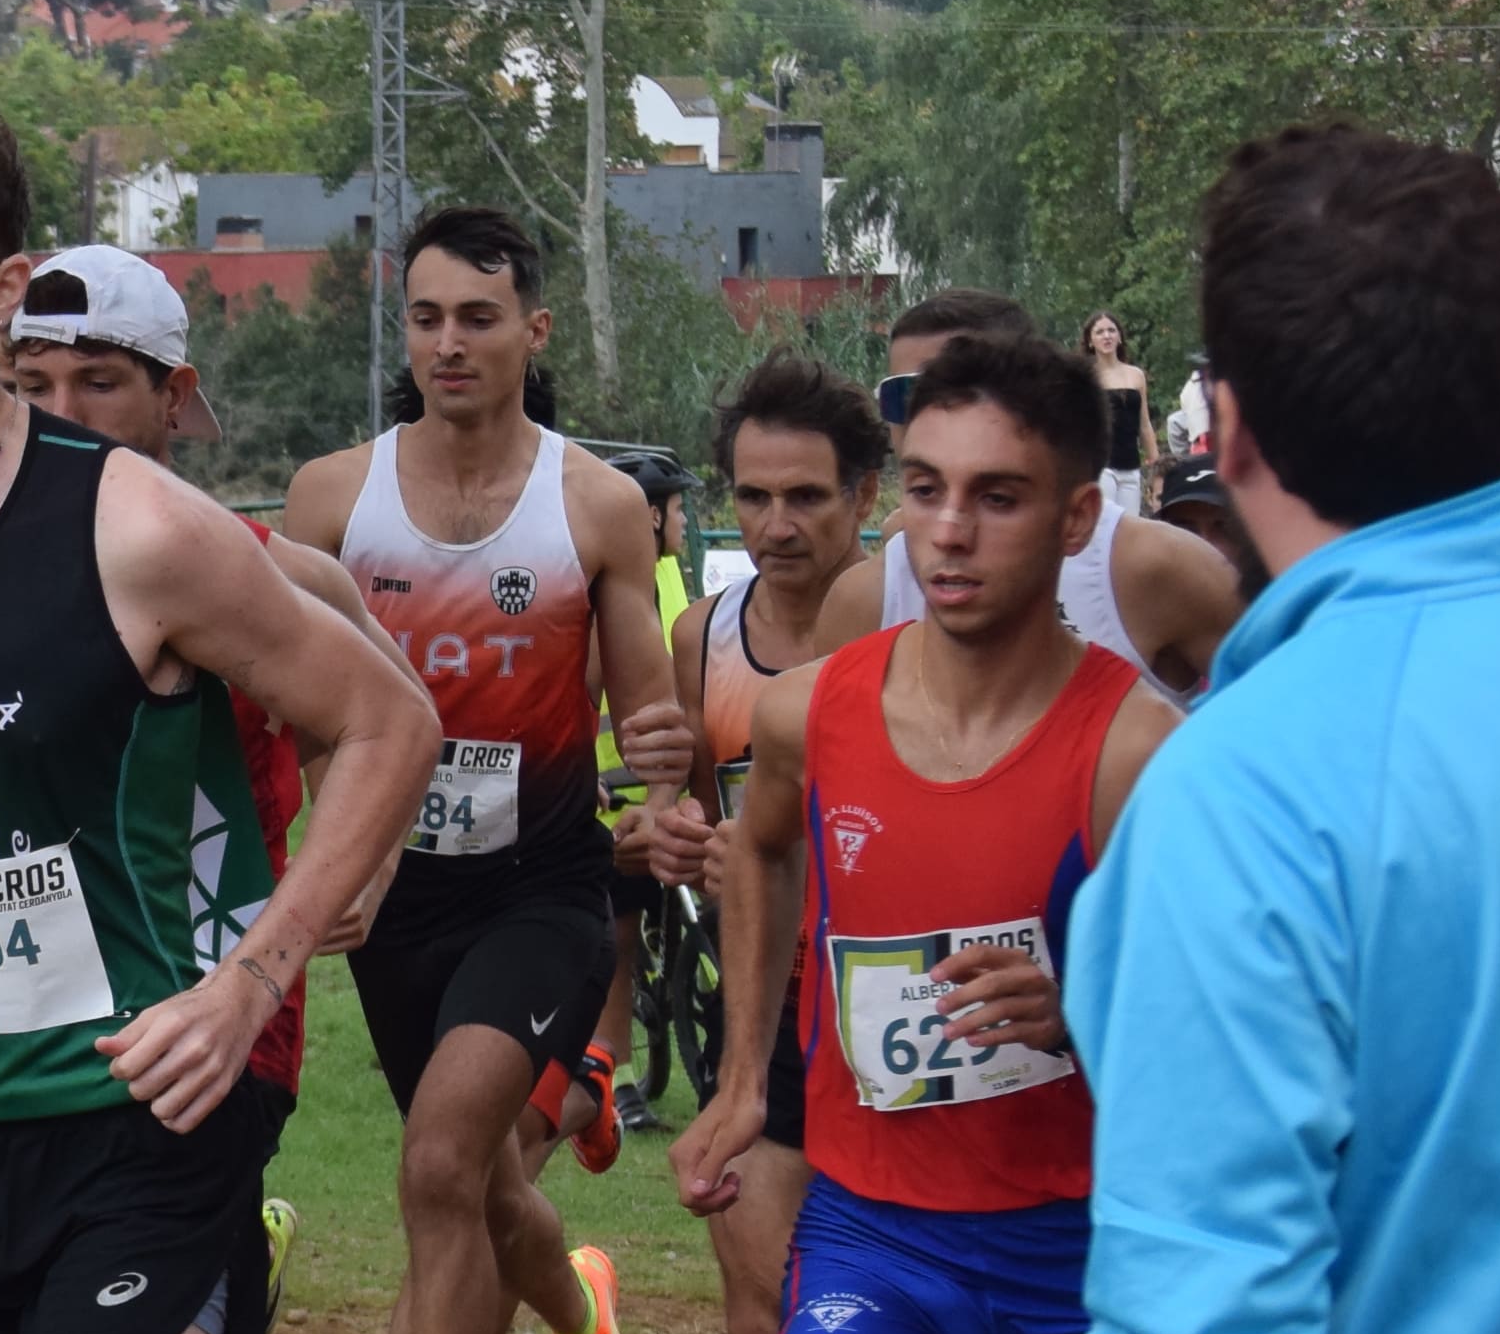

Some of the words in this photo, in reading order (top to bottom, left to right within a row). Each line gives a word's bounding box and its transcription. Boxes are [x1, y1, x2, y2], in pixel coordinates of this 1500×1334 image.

[459, 747, 514, 768] CROS
[415, 792, 475, 833] 84
[19, 889, 73, 910] CERDANYOLA
